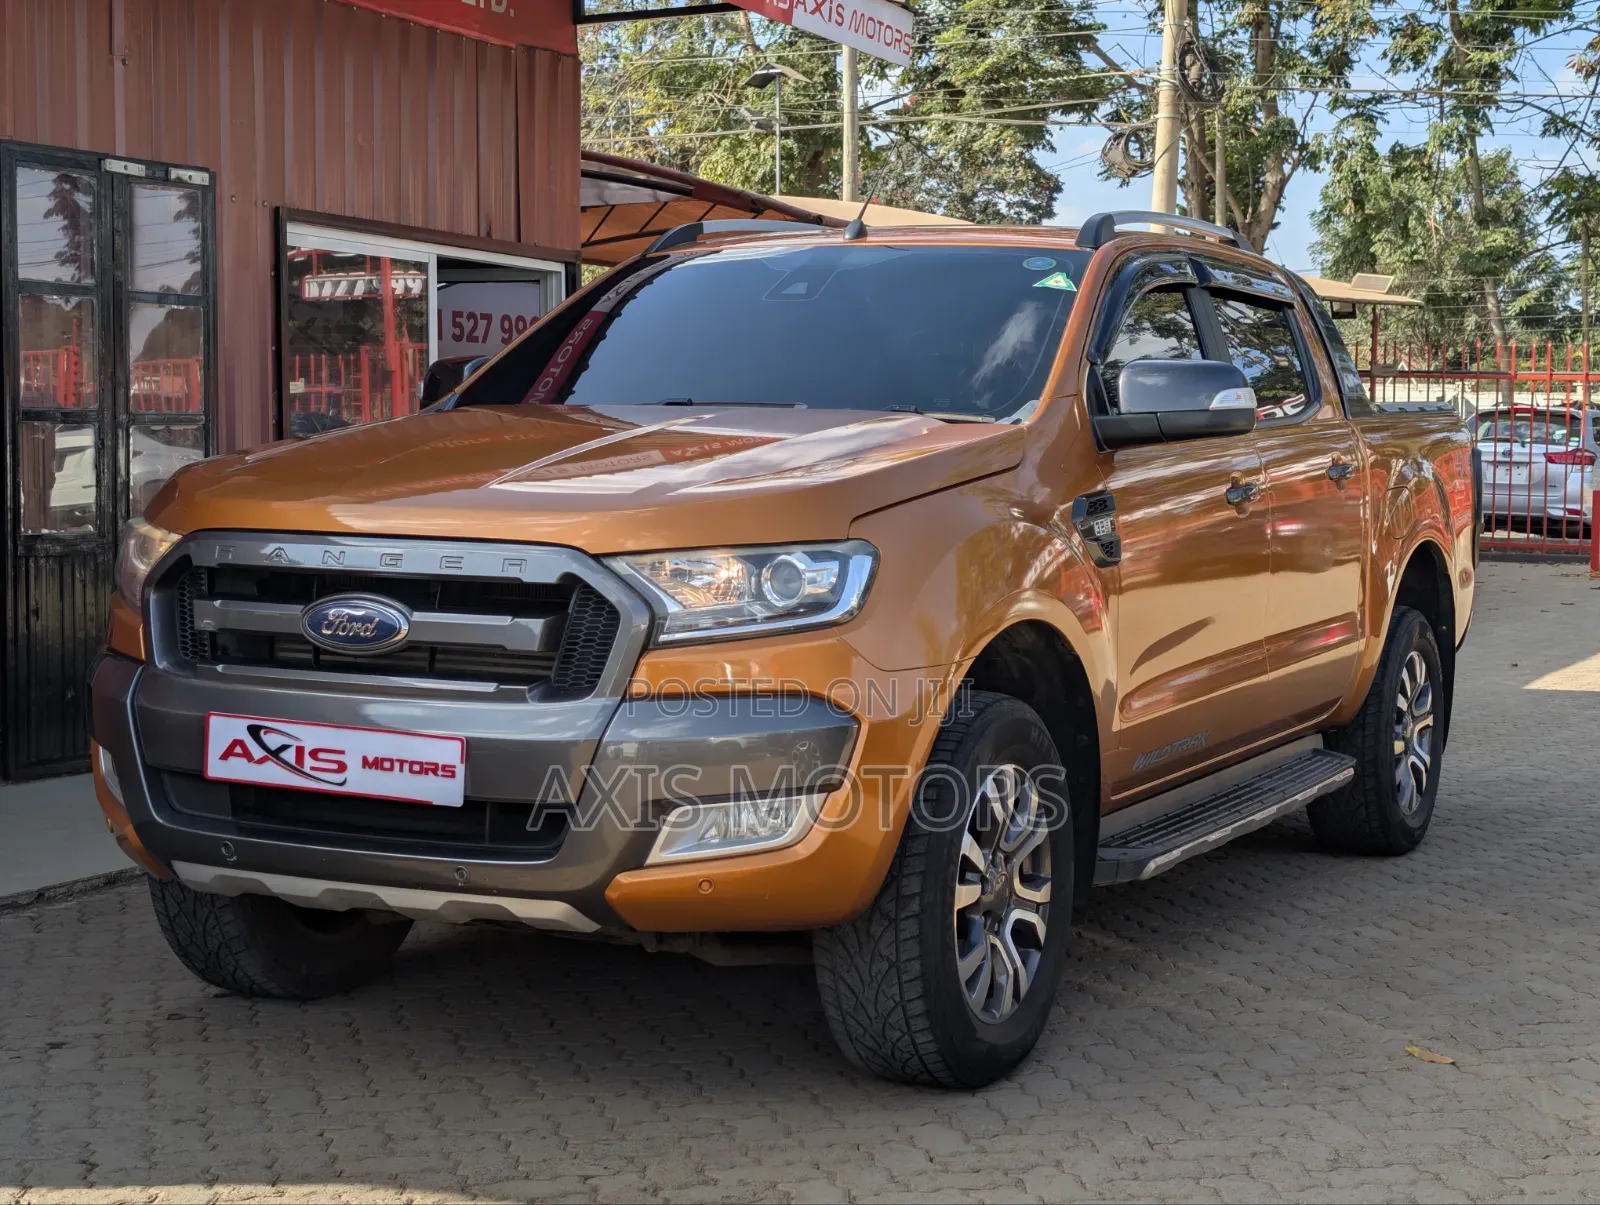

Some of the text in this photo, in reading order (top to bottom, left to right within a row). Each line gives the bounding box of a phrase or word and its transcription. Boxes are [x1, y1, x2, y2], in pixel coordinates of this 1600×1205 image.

[849, 9, 912, 56] MOTORS
[451, 310, 493, 344] 527
[214, 544, 528, 573] RANGER
[321, 608, 380, 639] Ford
[219, 727, 457, 783] AXIS MOTORS
[1132, 729, 1211, 772] WILDTRAK
